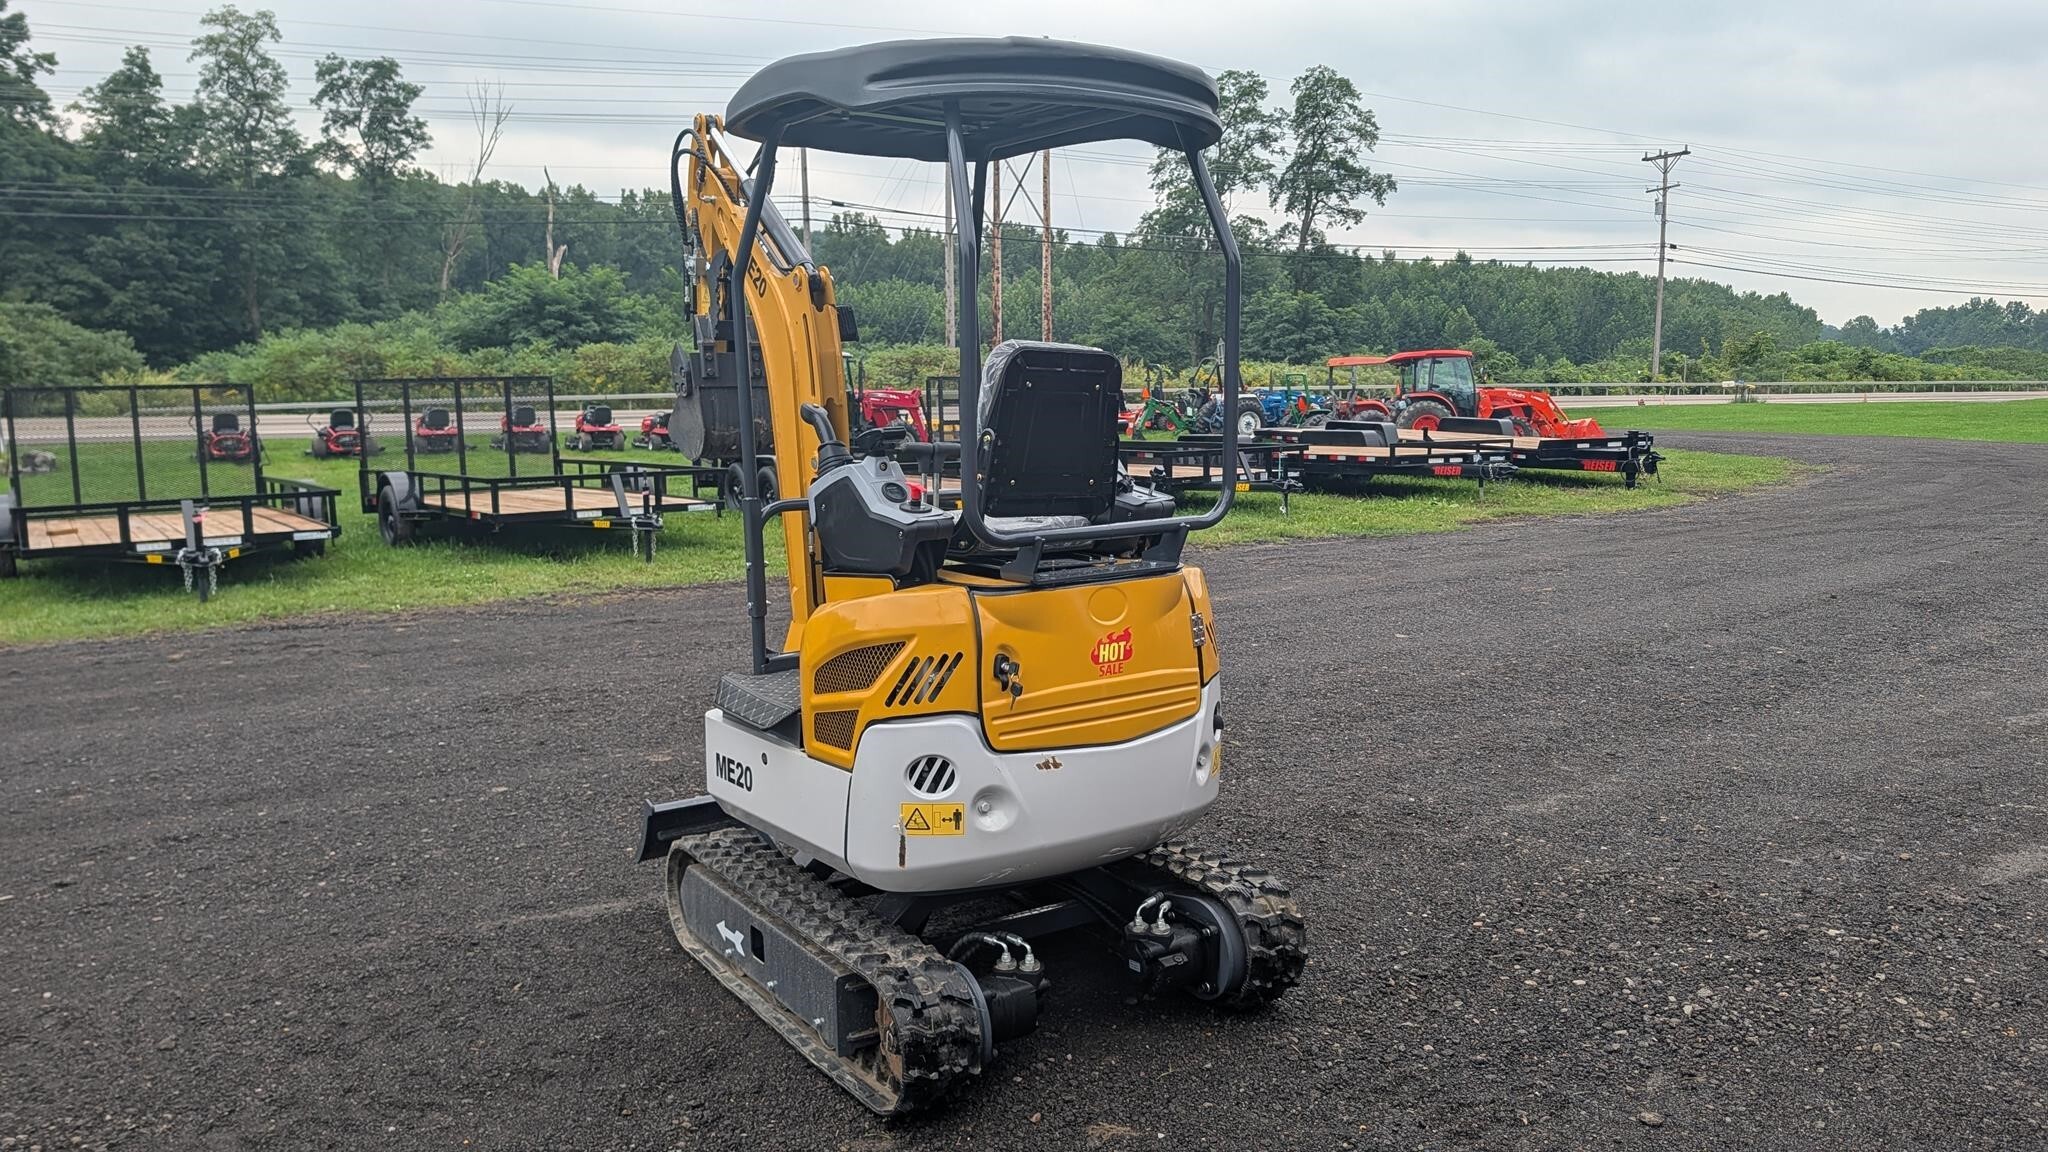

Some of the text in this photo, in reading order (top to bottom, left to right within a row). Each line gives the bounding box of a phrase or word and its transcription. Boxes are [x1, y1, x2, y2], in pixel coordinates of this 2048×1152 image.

[748, 256, 767, 298] E20
[1098, 641, 1127, 663] HOT
[1099, 662, 1123, 677] SALE
[715, 752, 753, 793] ME20
